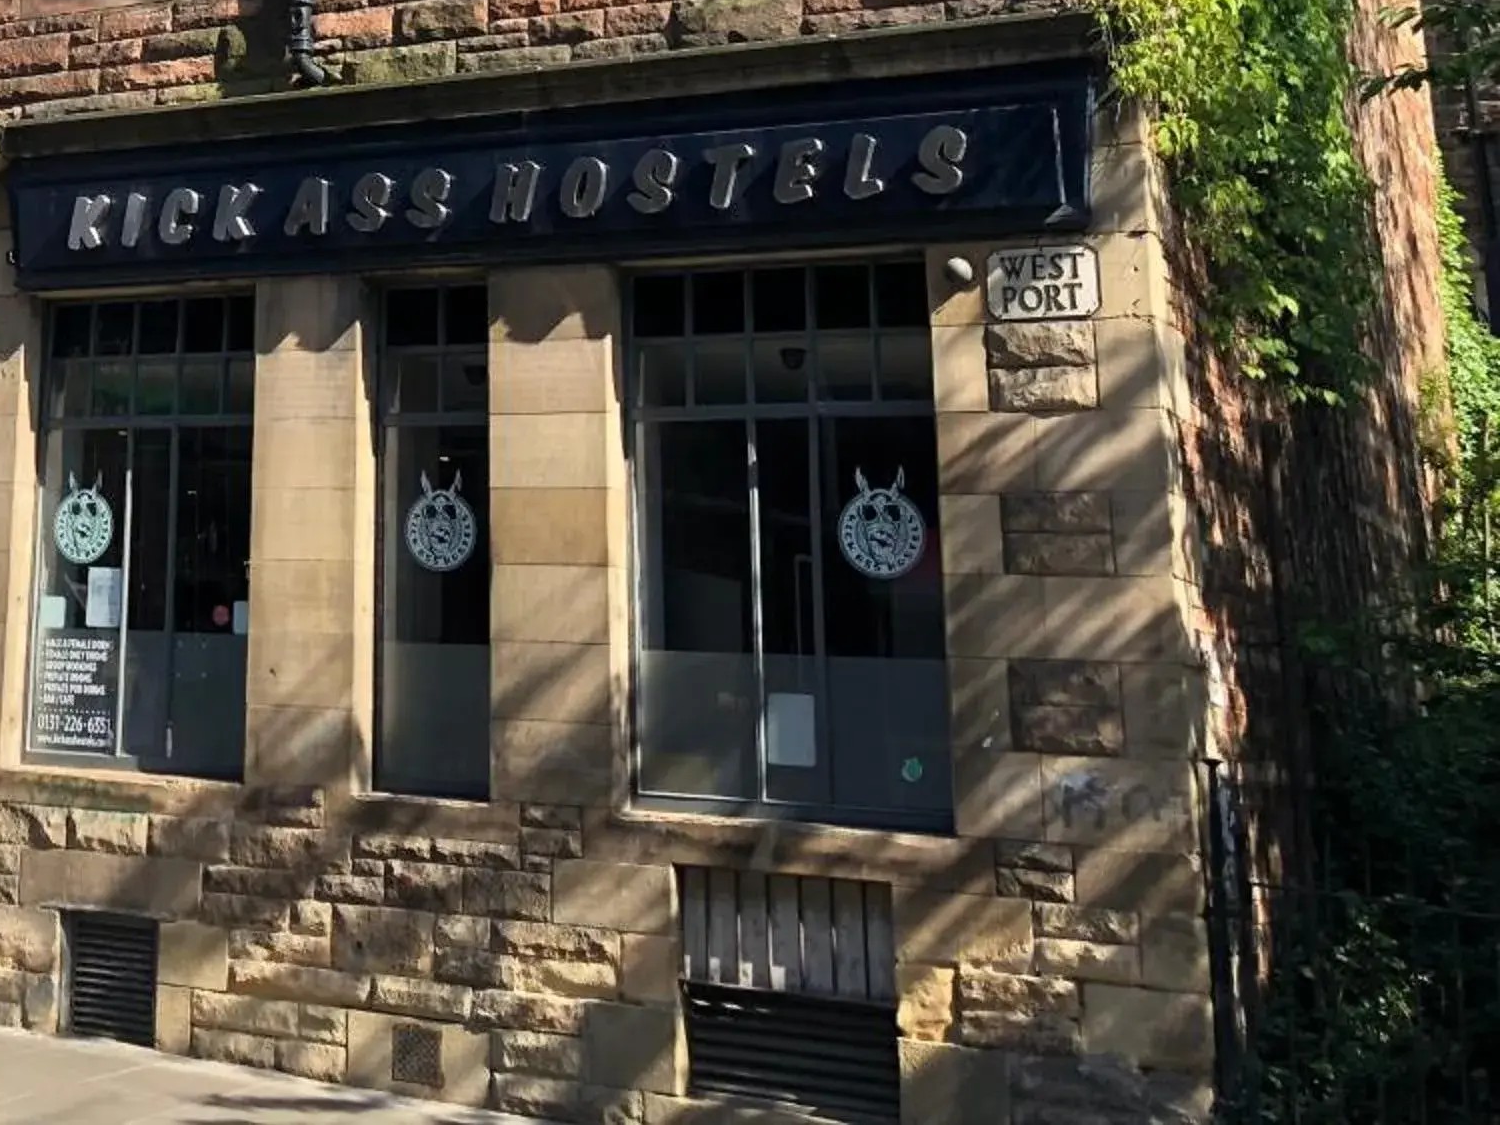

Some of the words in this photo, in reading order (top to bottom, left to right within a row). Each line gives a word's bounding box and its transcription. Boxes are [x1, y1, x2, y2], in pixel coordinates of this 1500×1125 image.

[67, 182, 258, 251] KICK
[283, 168, 453, 236] ASS
[489, 125, 967, 224] HOSTELS
[999, 252, 1083, 282] WEST
[1001, 284, 1084, 313] PORT
